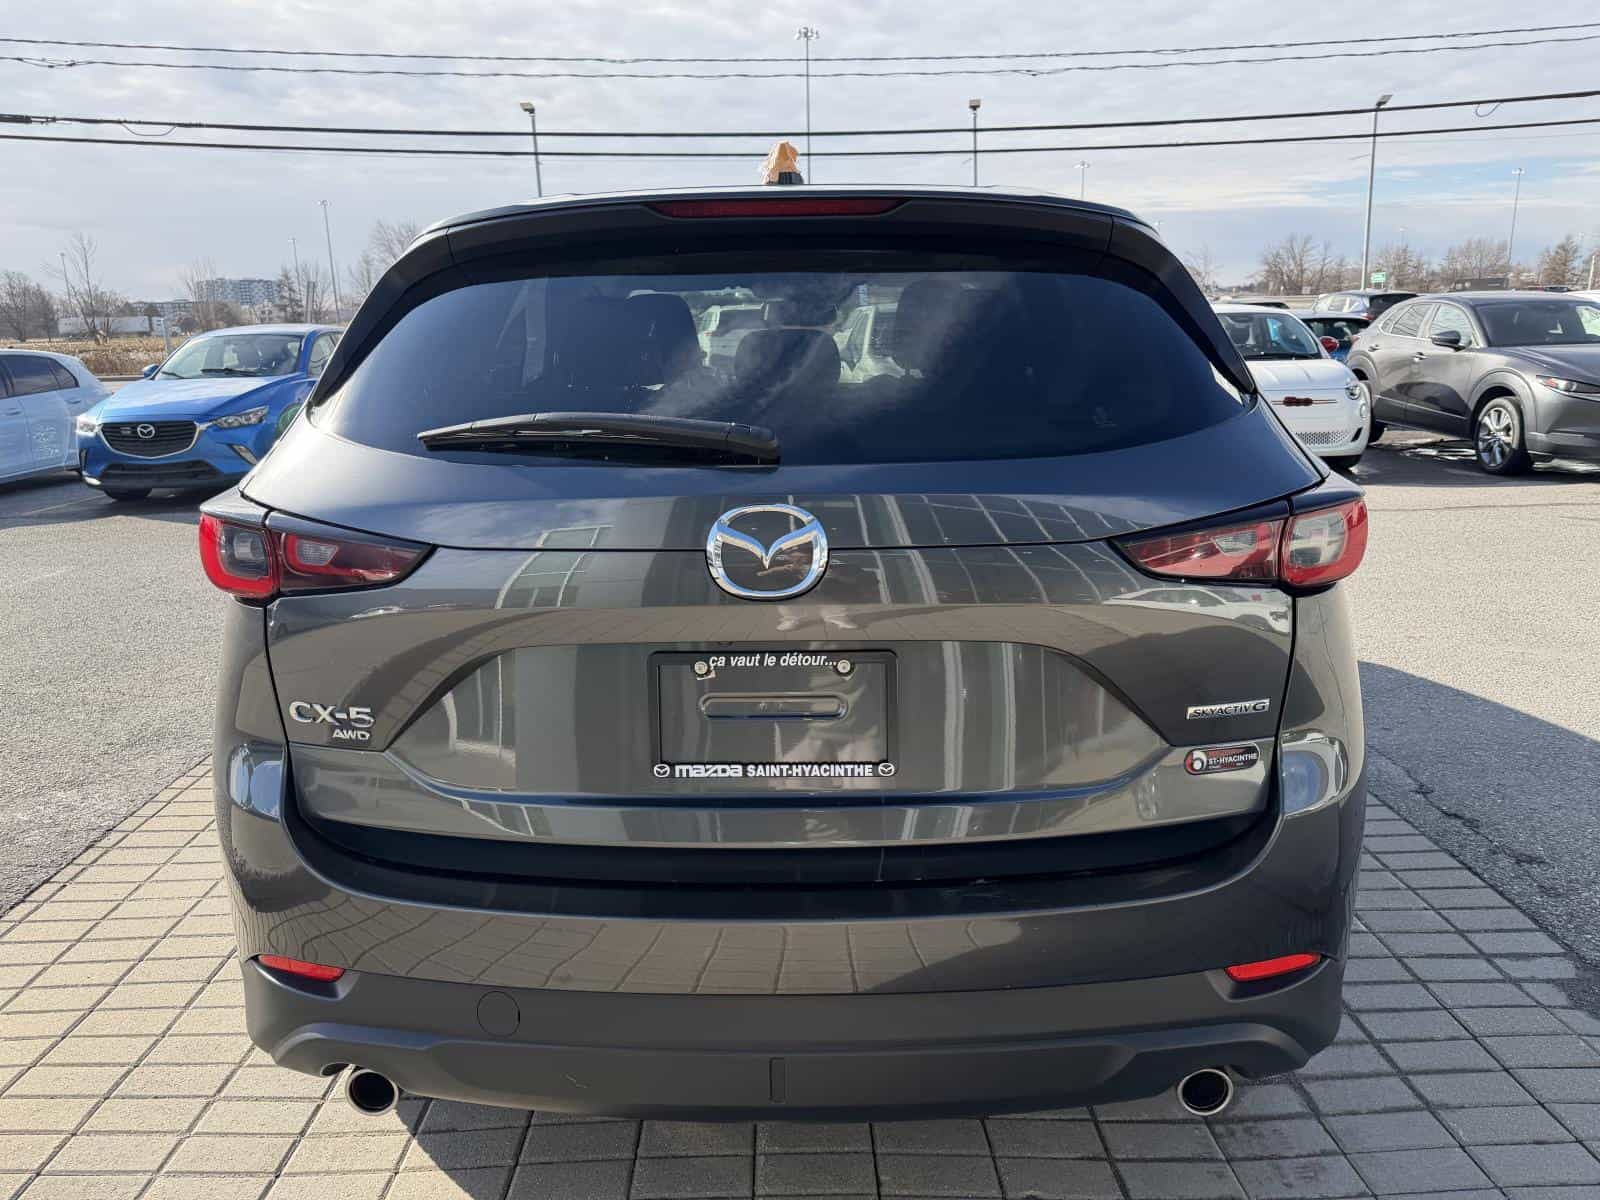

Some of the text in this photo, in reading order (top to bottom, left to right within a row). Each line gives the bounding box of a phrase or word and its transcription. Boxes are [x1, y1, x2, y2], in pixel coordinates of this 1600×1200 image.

[709, 656, 726, 670] ça
[730, 654, 760, 667] vaut
[763, 653, 777, 667] le
[289, 701, 375, 728] CX-5
[332, 729, 370, 740] AWD
[746, 764, 873, 777] SAINT-HYACINTHE
